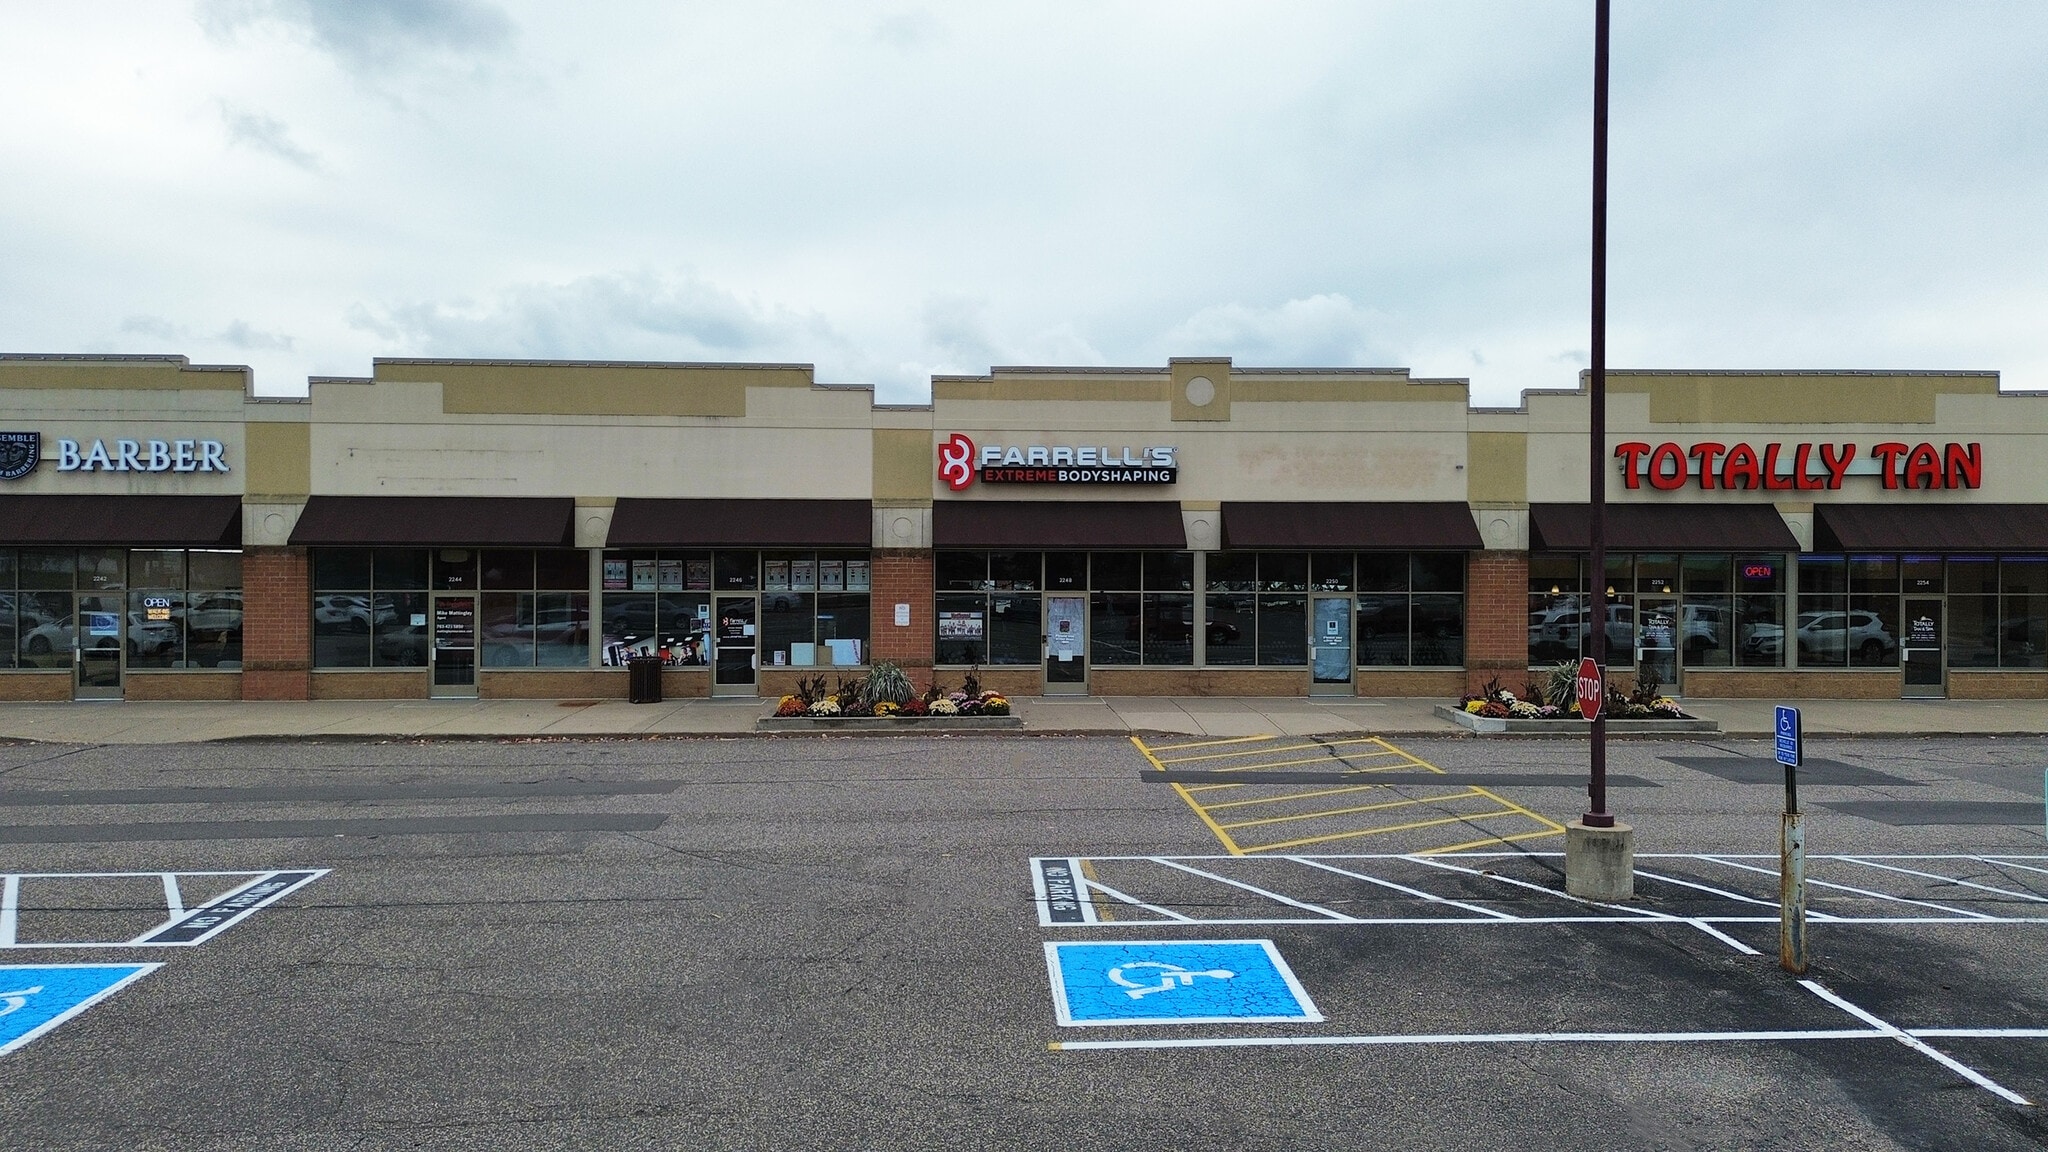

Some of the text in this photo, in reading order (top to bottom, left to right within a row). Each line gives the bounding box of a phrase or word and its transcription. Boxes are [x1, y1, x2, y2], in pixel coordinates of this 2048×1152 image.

[0, 434, 36, 442] EMBLE
[5, 444, 36, 477] BARBERING
[56, 439, 230, 472] BARBER
[981, 446, 1174, 467] FARRELL'S
[1614, 442, 1981, 490] TOTALLY TAN
[985, 469, 1171, 482] EXTREME BODYSHAPING
[1745, 566, 1771, 577] OPEN
[144, 597, 170, 607] OPEN
[1578, 676, 1600, 702] STOP
[1045, 866, 1077, 911] NO PARKING
[181, 881, 287, 929] NO PARKING
